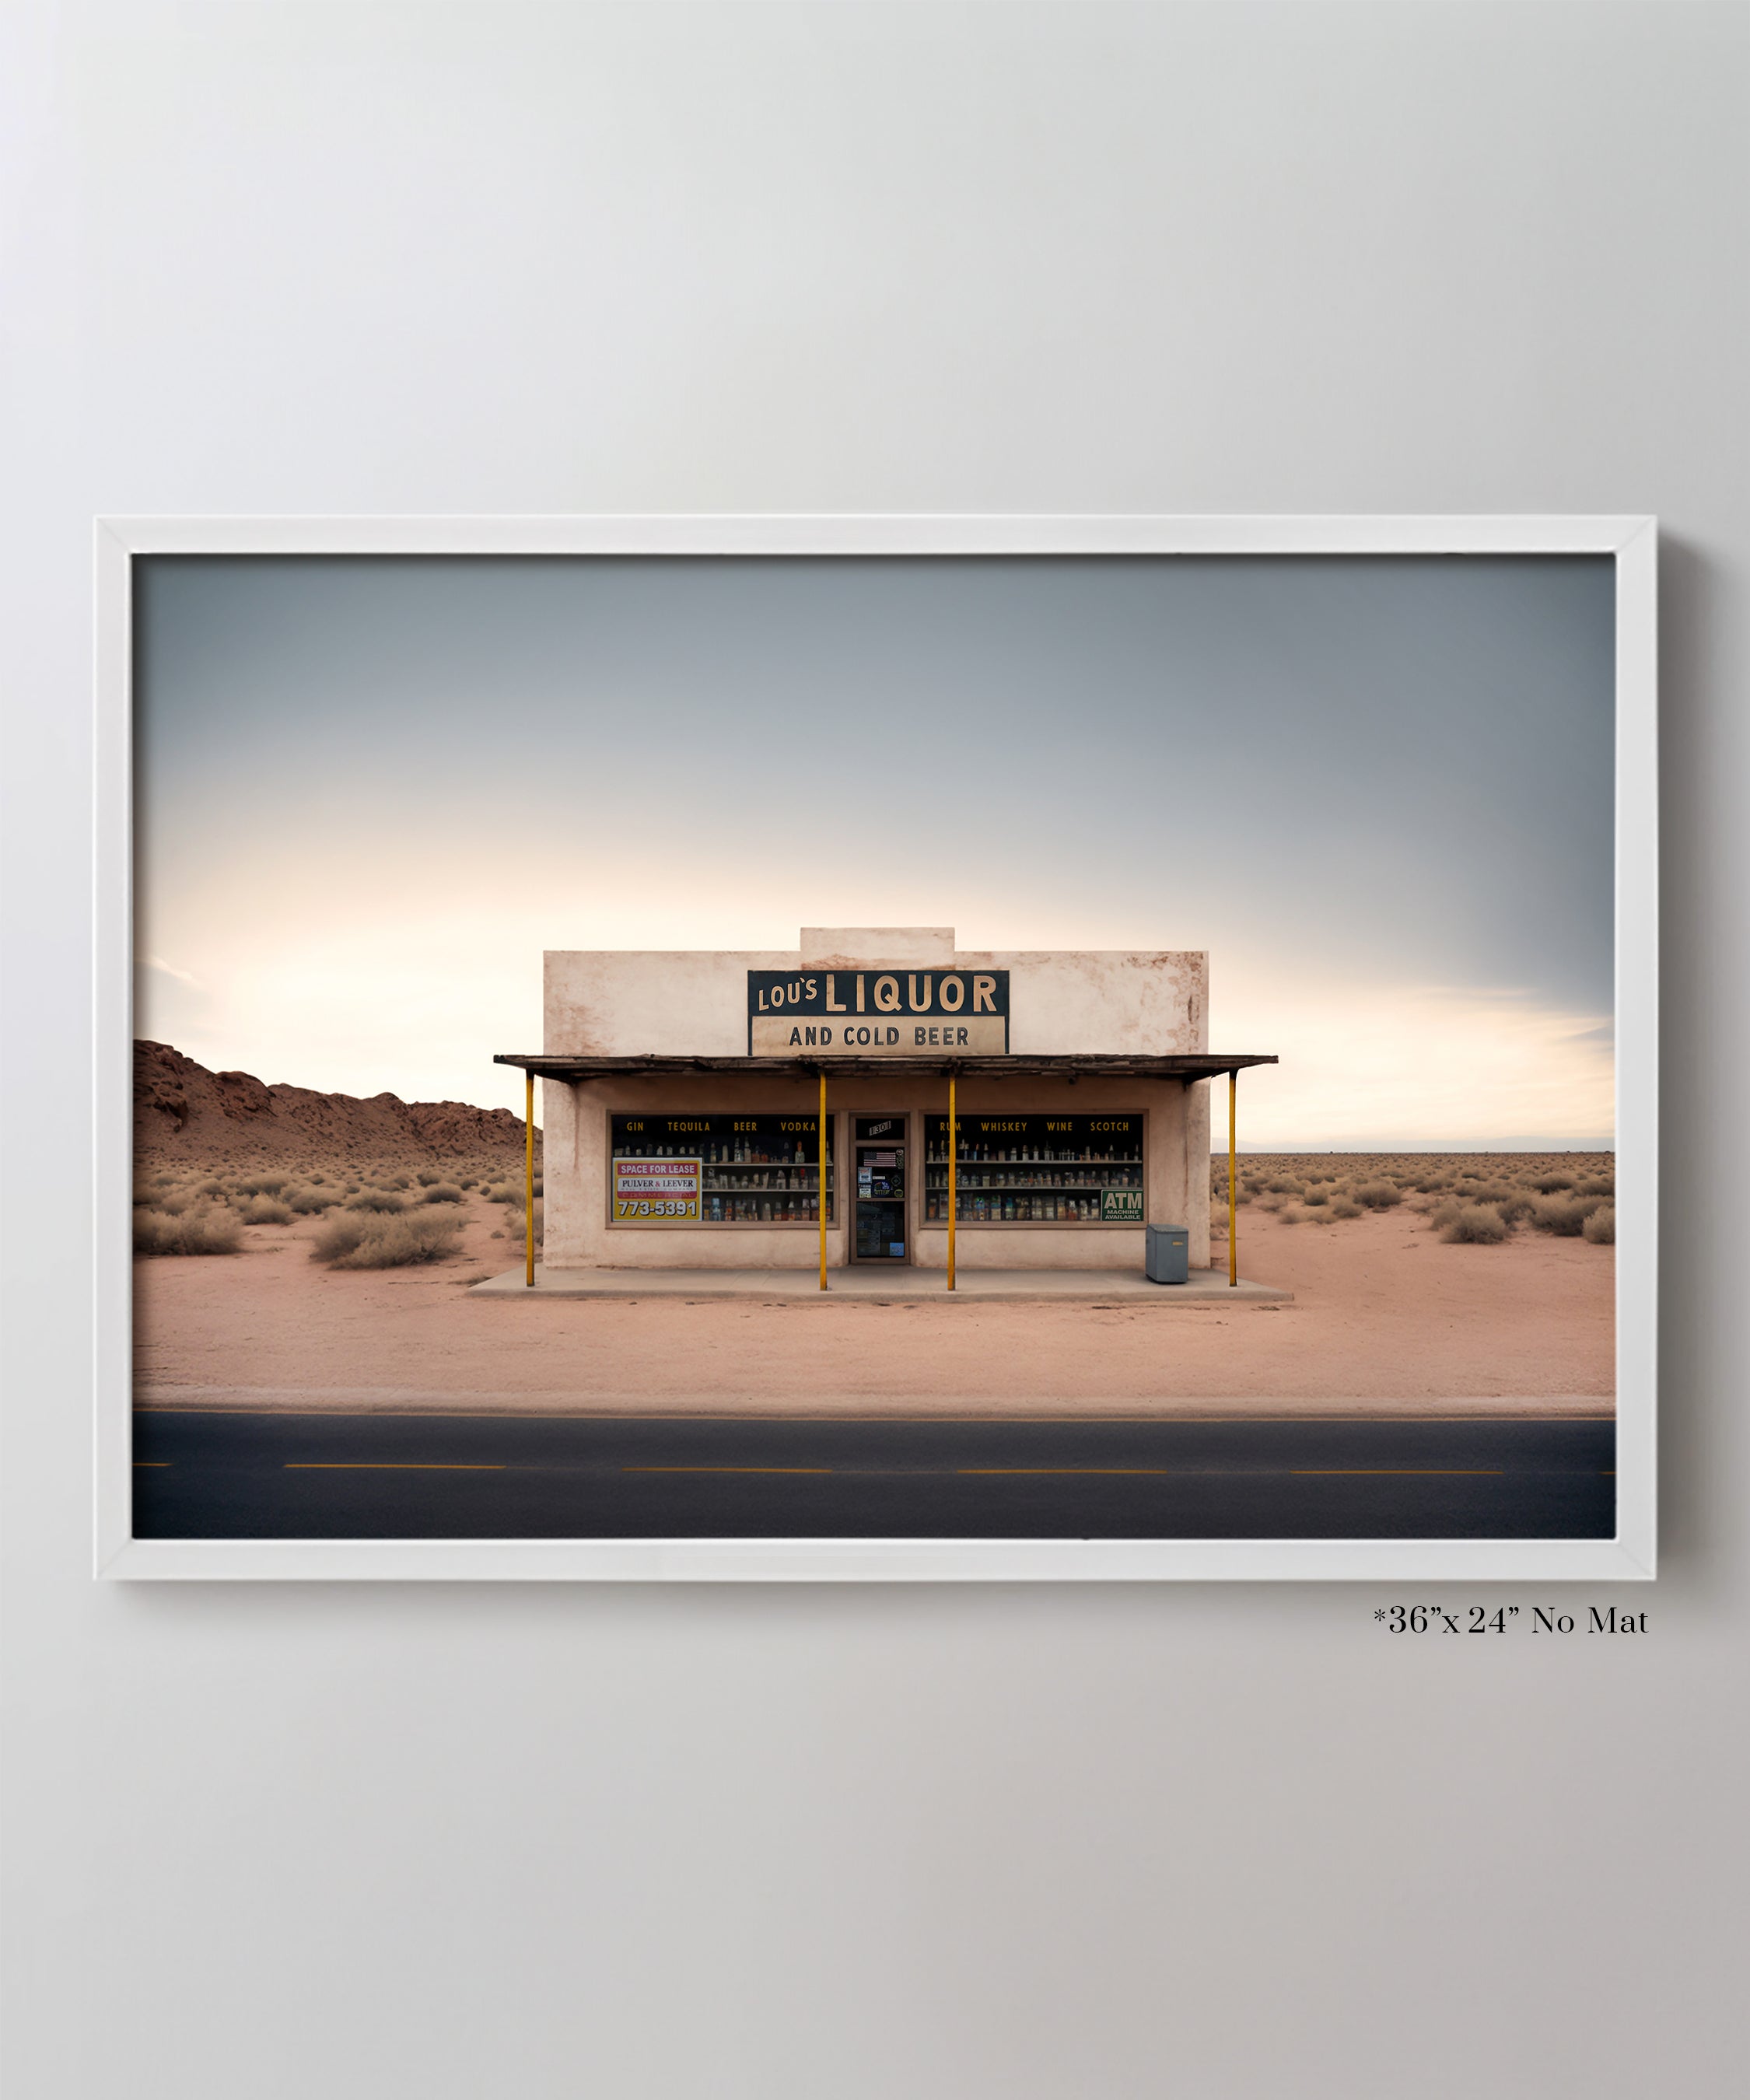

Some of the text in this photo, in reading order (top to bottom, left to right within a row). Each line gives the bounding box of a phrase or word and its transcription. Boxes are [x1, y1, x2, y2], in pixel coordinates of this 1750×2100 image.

[758, 974, 997, 1012] LOU'S LIQUOR
[789, 1027, 969, 1046] AND COLD BEER
[627, 1122, 816, 1132] GIN TEQUILA BEER VODKA
[981, 1122, 1027, 1132] WHISKEY
[1047, 1122, 1073, 1131] WINE
[1090, 1122, 1129, 1131] SCOTCH
[621, 1165, 695, 1174] SPACE FOR LEASE
[1104, 1192, 1142, 1209] ATM
[618, 1201, 697, 1216] 773-5391
